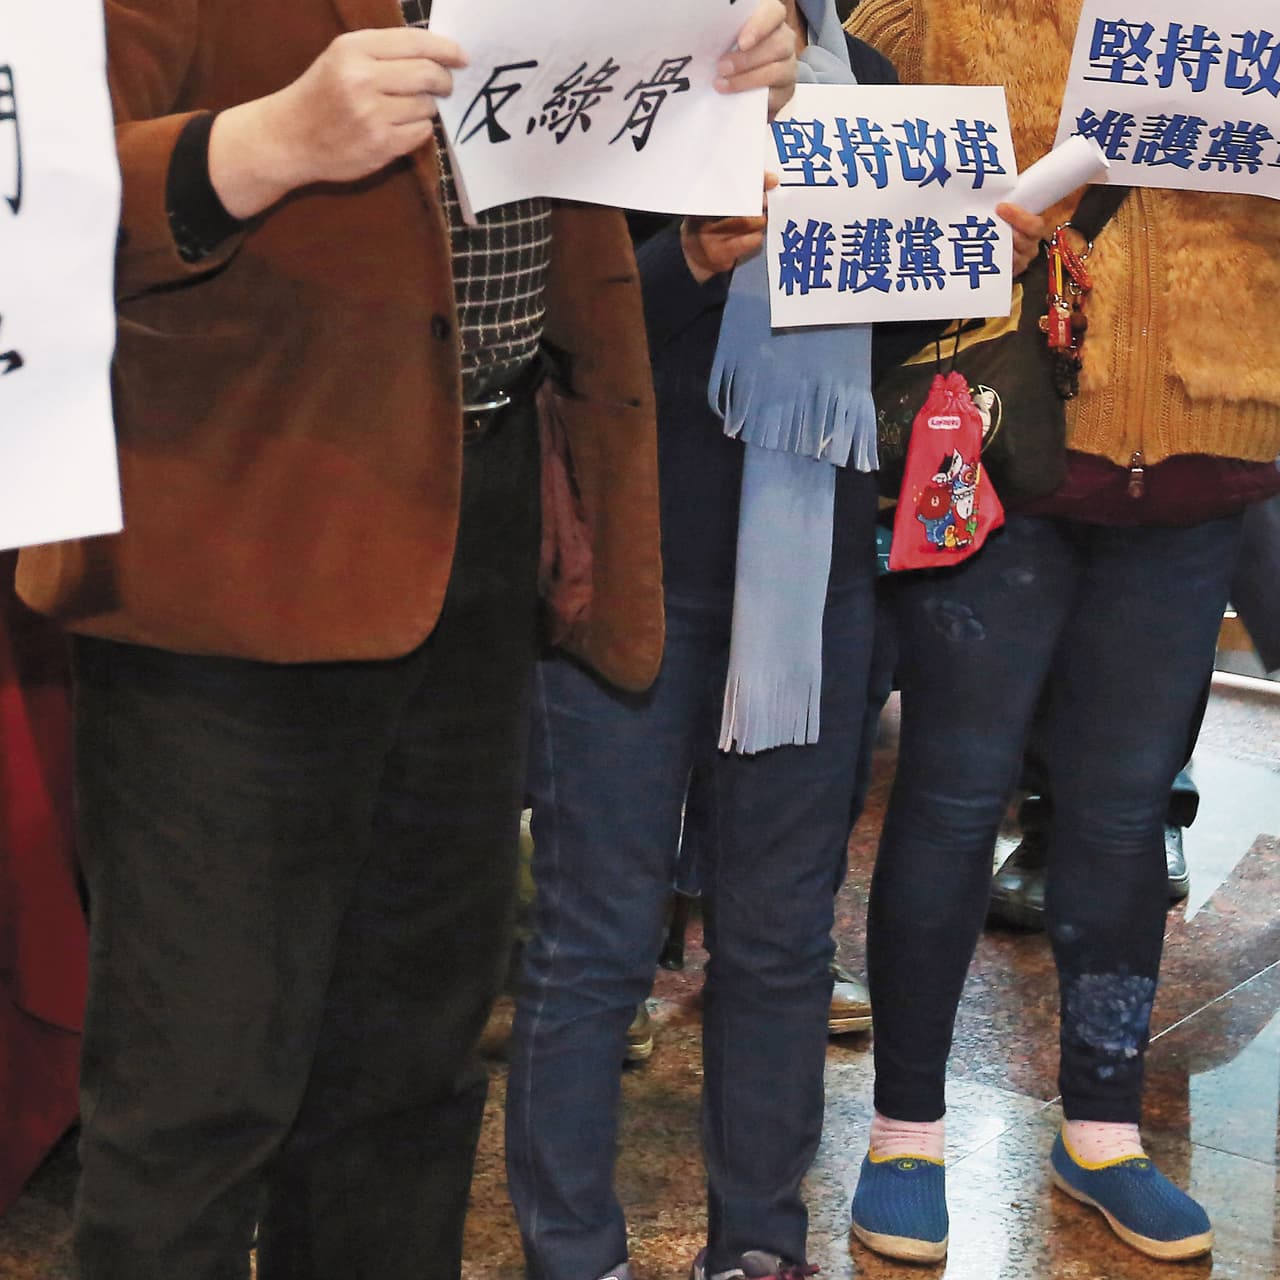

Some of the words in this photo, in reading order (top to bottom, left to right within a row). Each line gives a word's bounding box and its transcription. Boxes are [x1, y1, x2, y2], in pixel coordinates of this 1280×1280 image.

[453, 54, 694, 153] 反綠骨
[769, 116, 1008, 190] 堅持改革
[777, 215, 1001, 297] 維護黨章
